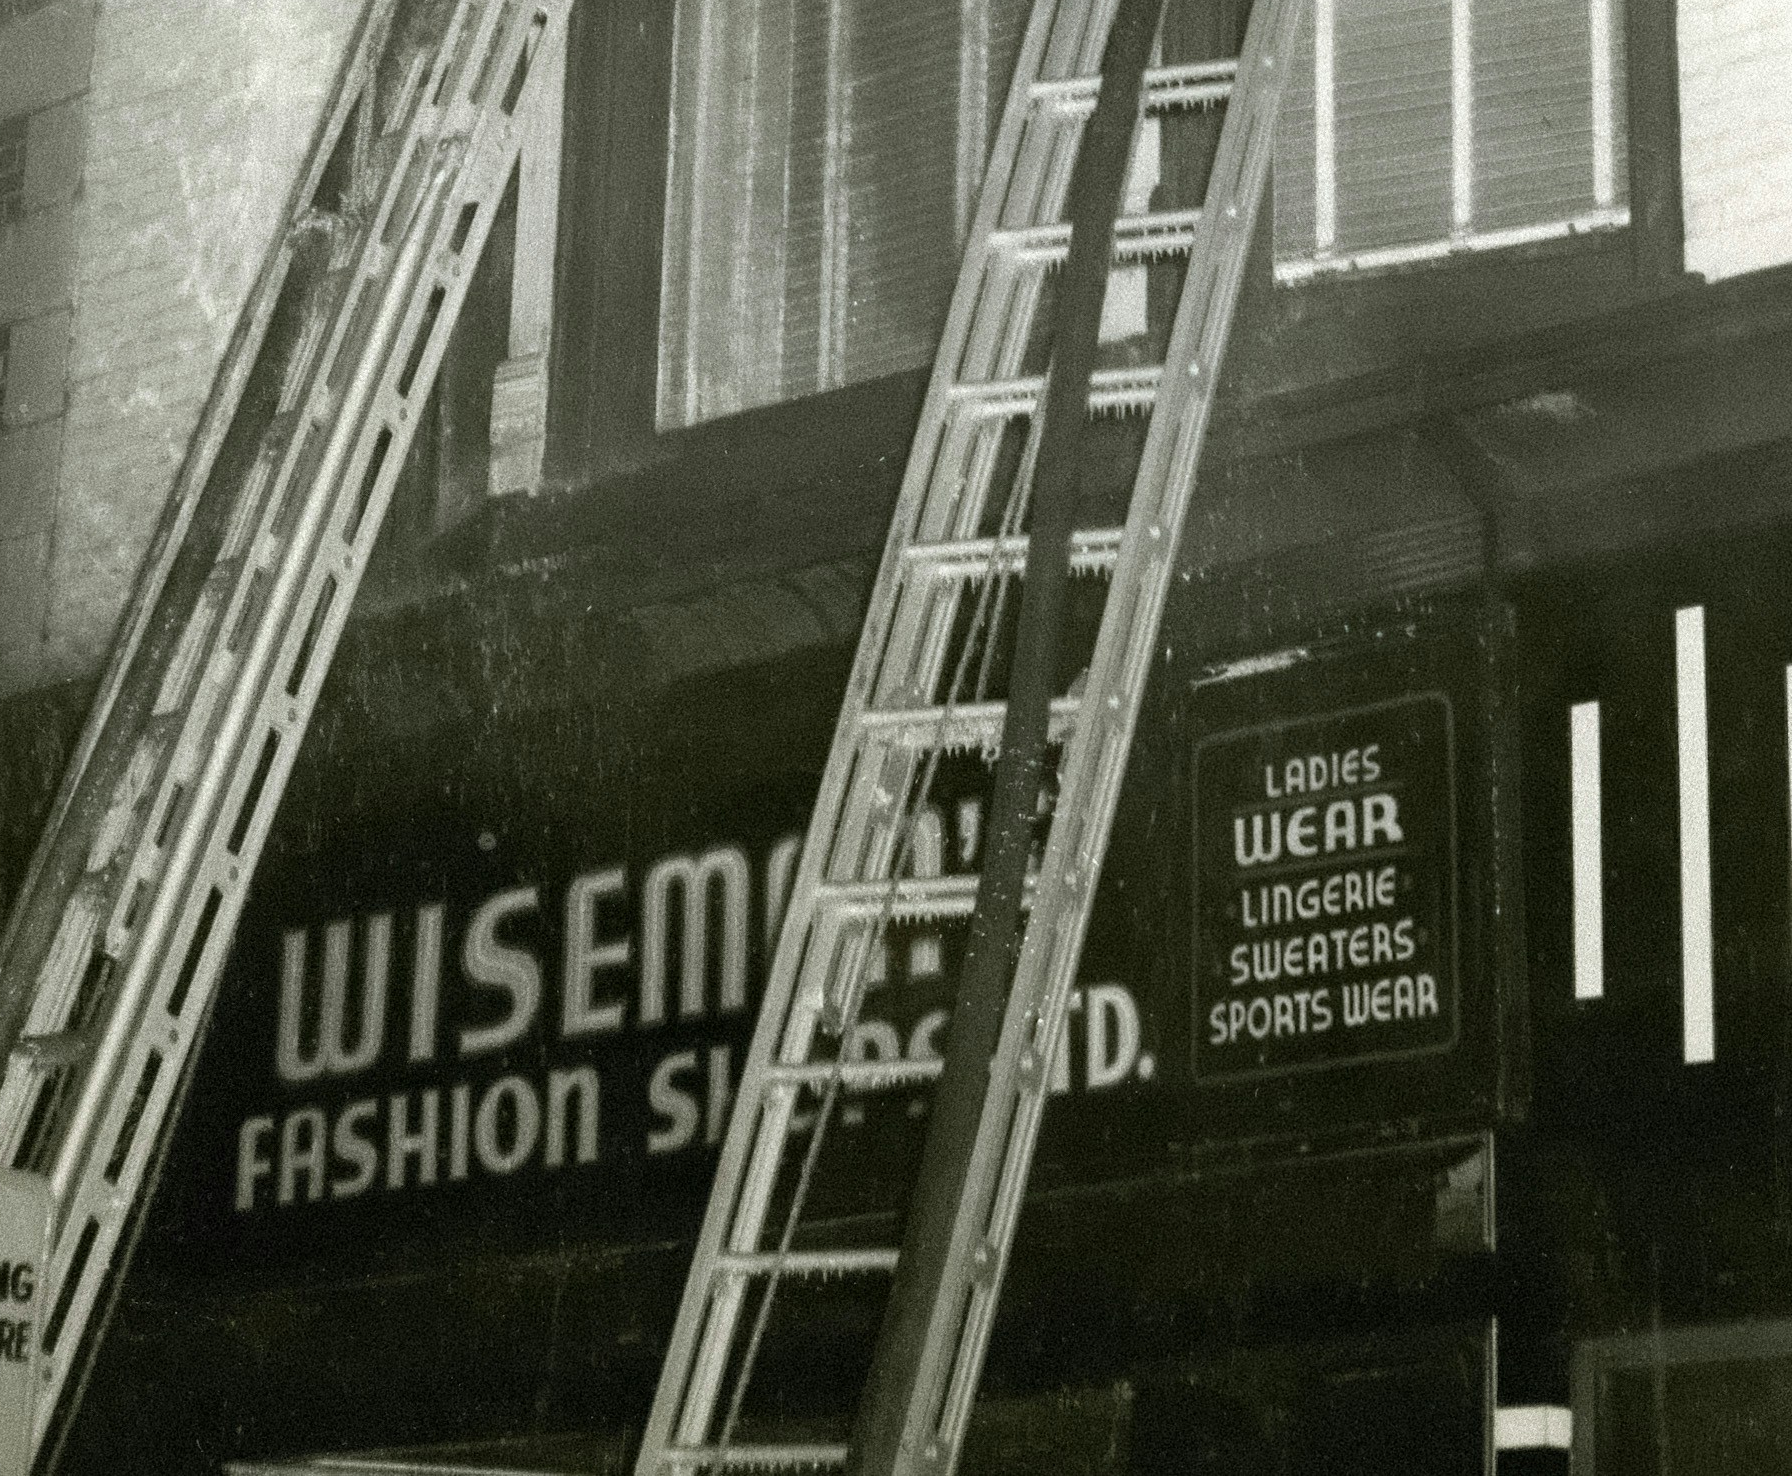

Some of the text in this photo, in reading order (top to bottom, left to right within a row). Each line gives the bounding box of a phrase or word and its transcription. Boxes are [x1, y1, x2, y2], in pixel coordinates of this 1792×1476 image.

[1265, 744, 1381, 798] LADIES
[1234, 793, 1404, 867] WEAR
[1242, 867, 1396, 928] LINGERIE
[1230, 916, 1416, 986] SWEATERS
[1209, 973, 1439, 1045] SPORTS WEAR
[235, 1066, 602, 1211] FASHION
